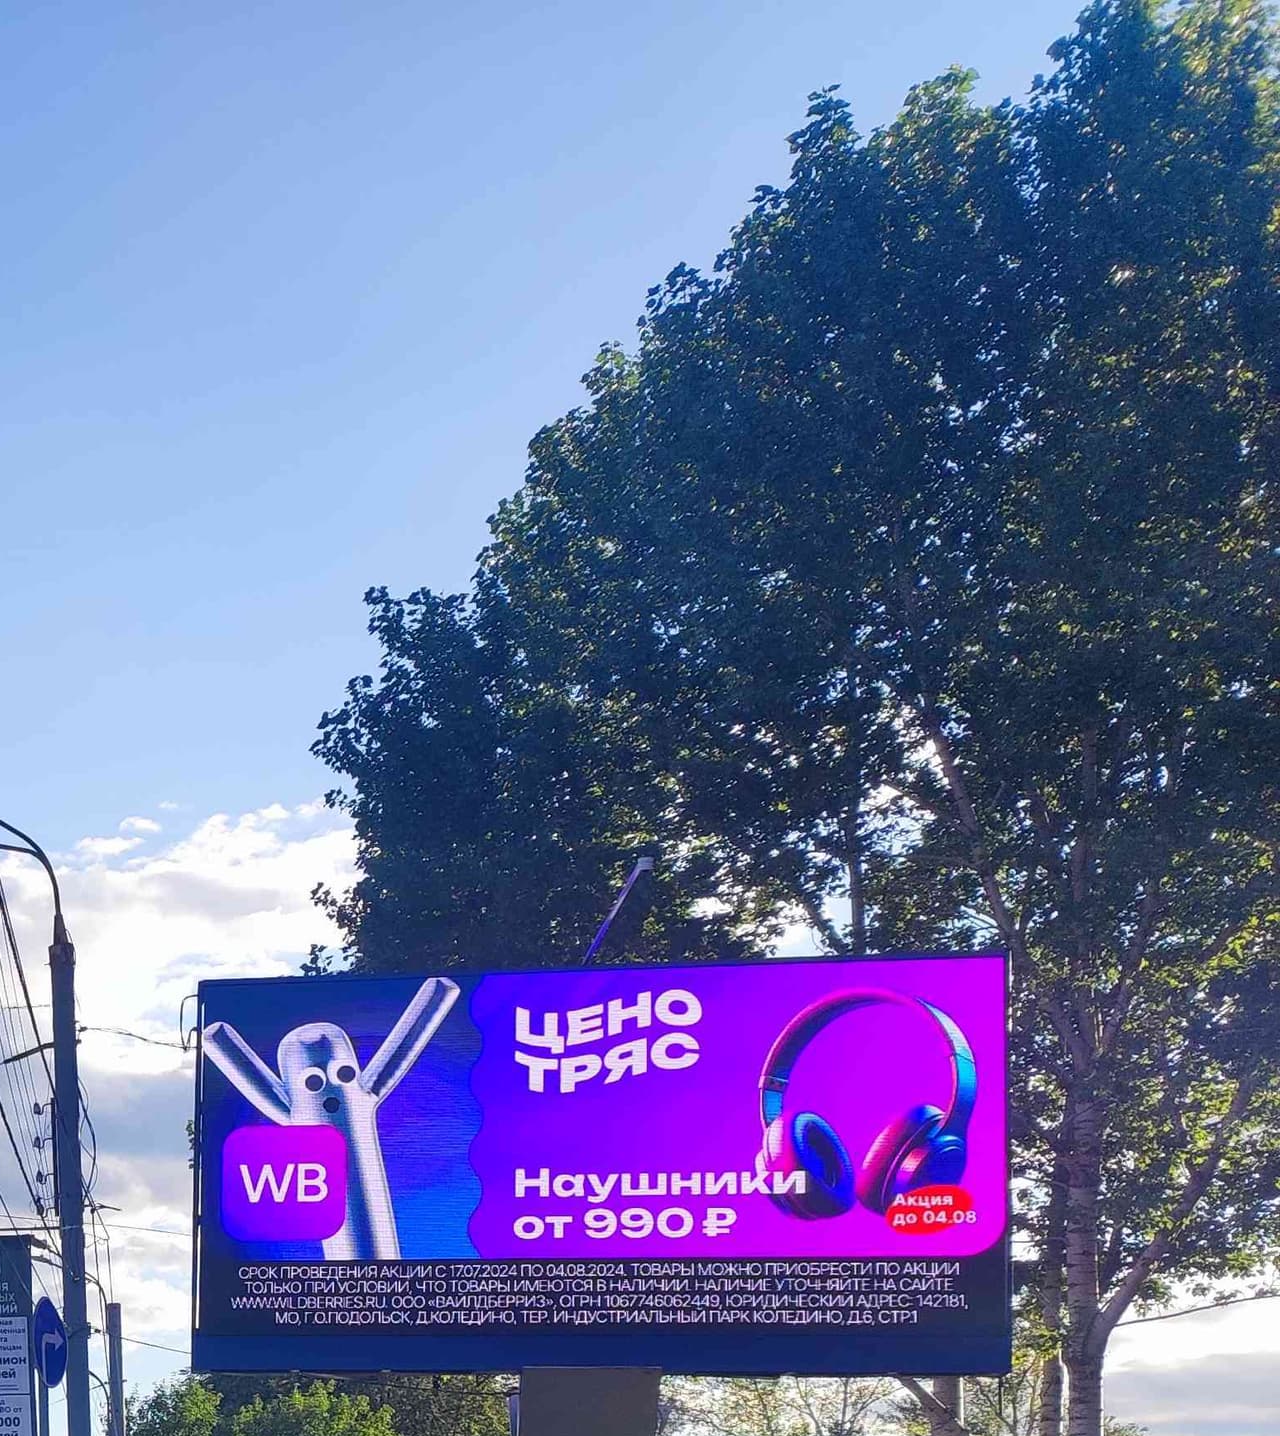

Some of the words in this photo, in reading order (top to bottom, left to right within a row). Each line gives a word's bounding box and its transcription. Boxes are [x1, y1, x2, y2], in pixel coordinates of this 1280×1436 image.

[515, 988, 703, 1054] ЦЕНО
[514, 1032, 701, 1093] ТРЯС
[239, 1163, 329, 1203] WB
[514, 1168, 807, 1203] Наушники
[892, 1193, 953, 1208] Акция
[513, 1215, 573, 1239] от
[583, 1207, 695, 1239] 990
[892, 1213, 918, 1227] до
[922, 1210, 977, 1224] 04.08
[238, 1266, 279, 1279] СРОК
[280, 1266, 378, 1281] ПРОВЕДЕНИЯ
[380, 1265, 432, 1280] АКЦИИ
[435, 1265, 446, 1278] С
[521, 1264, 543, 1277] ПО
[631, 1263, 694, 1276] ТОВАРЫ
[697, 1262, 762, 1276] МОЖНО
[765, 1262, 872, 1276] ПРИОБРЕСТИ
[876, 1262, 900, 1275] ПО
[903, 1262, 960, 1277] АКЦИИ
[244, 1281, 301, 1294] ТОЛЬКО
[304, 1281, 335, 1294] ПРИ
[337, 1281, 412, 1295] УСЛОВИИ,
[416, 1280, 446, 1293] ЧТО
[451, 1280, 510, 1293] ТОВАРЫ
[514, 1279, 593, 1292] ИМЕЮТСЯ
[597, 1279, 606, 1292] В
[695, 1278, 771, 1291] НАЛИЧИЕ
[776, 1276, 871, 1291] УТОЧНЯЙТЕ
[874, 1278, 896, 1291] НА
[899, 1276, 954, 1291] САЙТЕ
[391, 1296, 426, 1308] ООО
[559, 1294, 601, 1307] ОГРН
[726, 1293, 854, 1308] ЮРИДИЧЕСКИЙ
[275, 1311, 301, 1325] МО,
[522, 1311, 550, 1323] ТЕР.
[554, 1308, 706, 1324] ИНДУСТРИАЛЬНЫЙ
[709, 1310, 750, 1323] ПАРК
[753, 1311, 845, 1325] КОЛЕДИНО,
